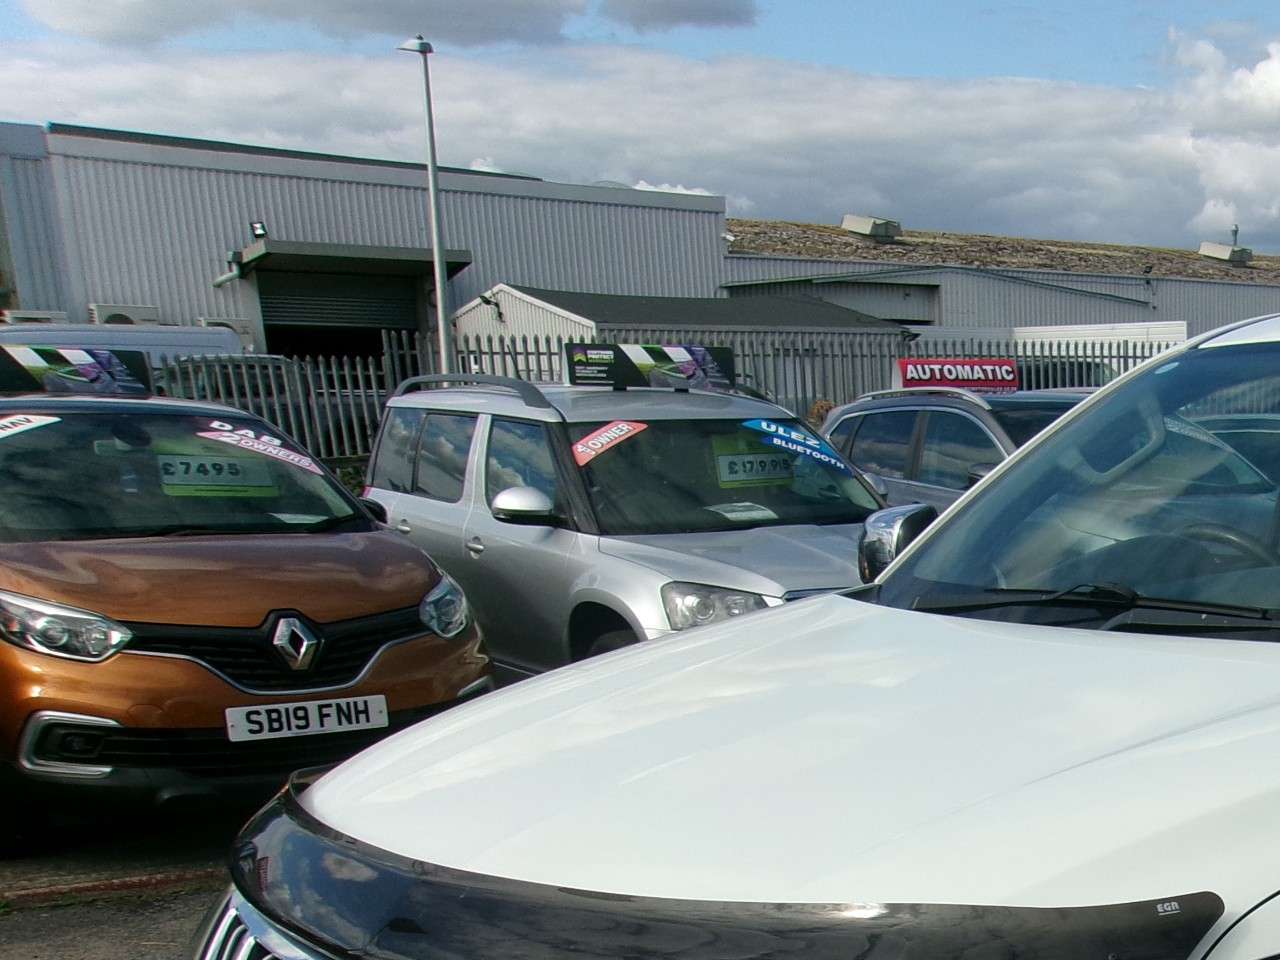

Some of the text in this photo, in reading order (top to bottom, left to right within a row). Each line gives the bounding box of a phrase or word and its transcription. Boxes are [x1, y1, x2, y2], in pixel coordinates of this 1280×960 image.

[906, 364, 1014, 380] AUTOMATIC
[209, 420, 283, 447] DAB
[587, 423, 635, 449] OWNER
[760, 420, 820, 449] ULEZ
[240, 439, 312, 467] OWNERS
[772, 437, 846, 470] BLUETOOTH
[245, 700, 371, 735] SB19 FNH
